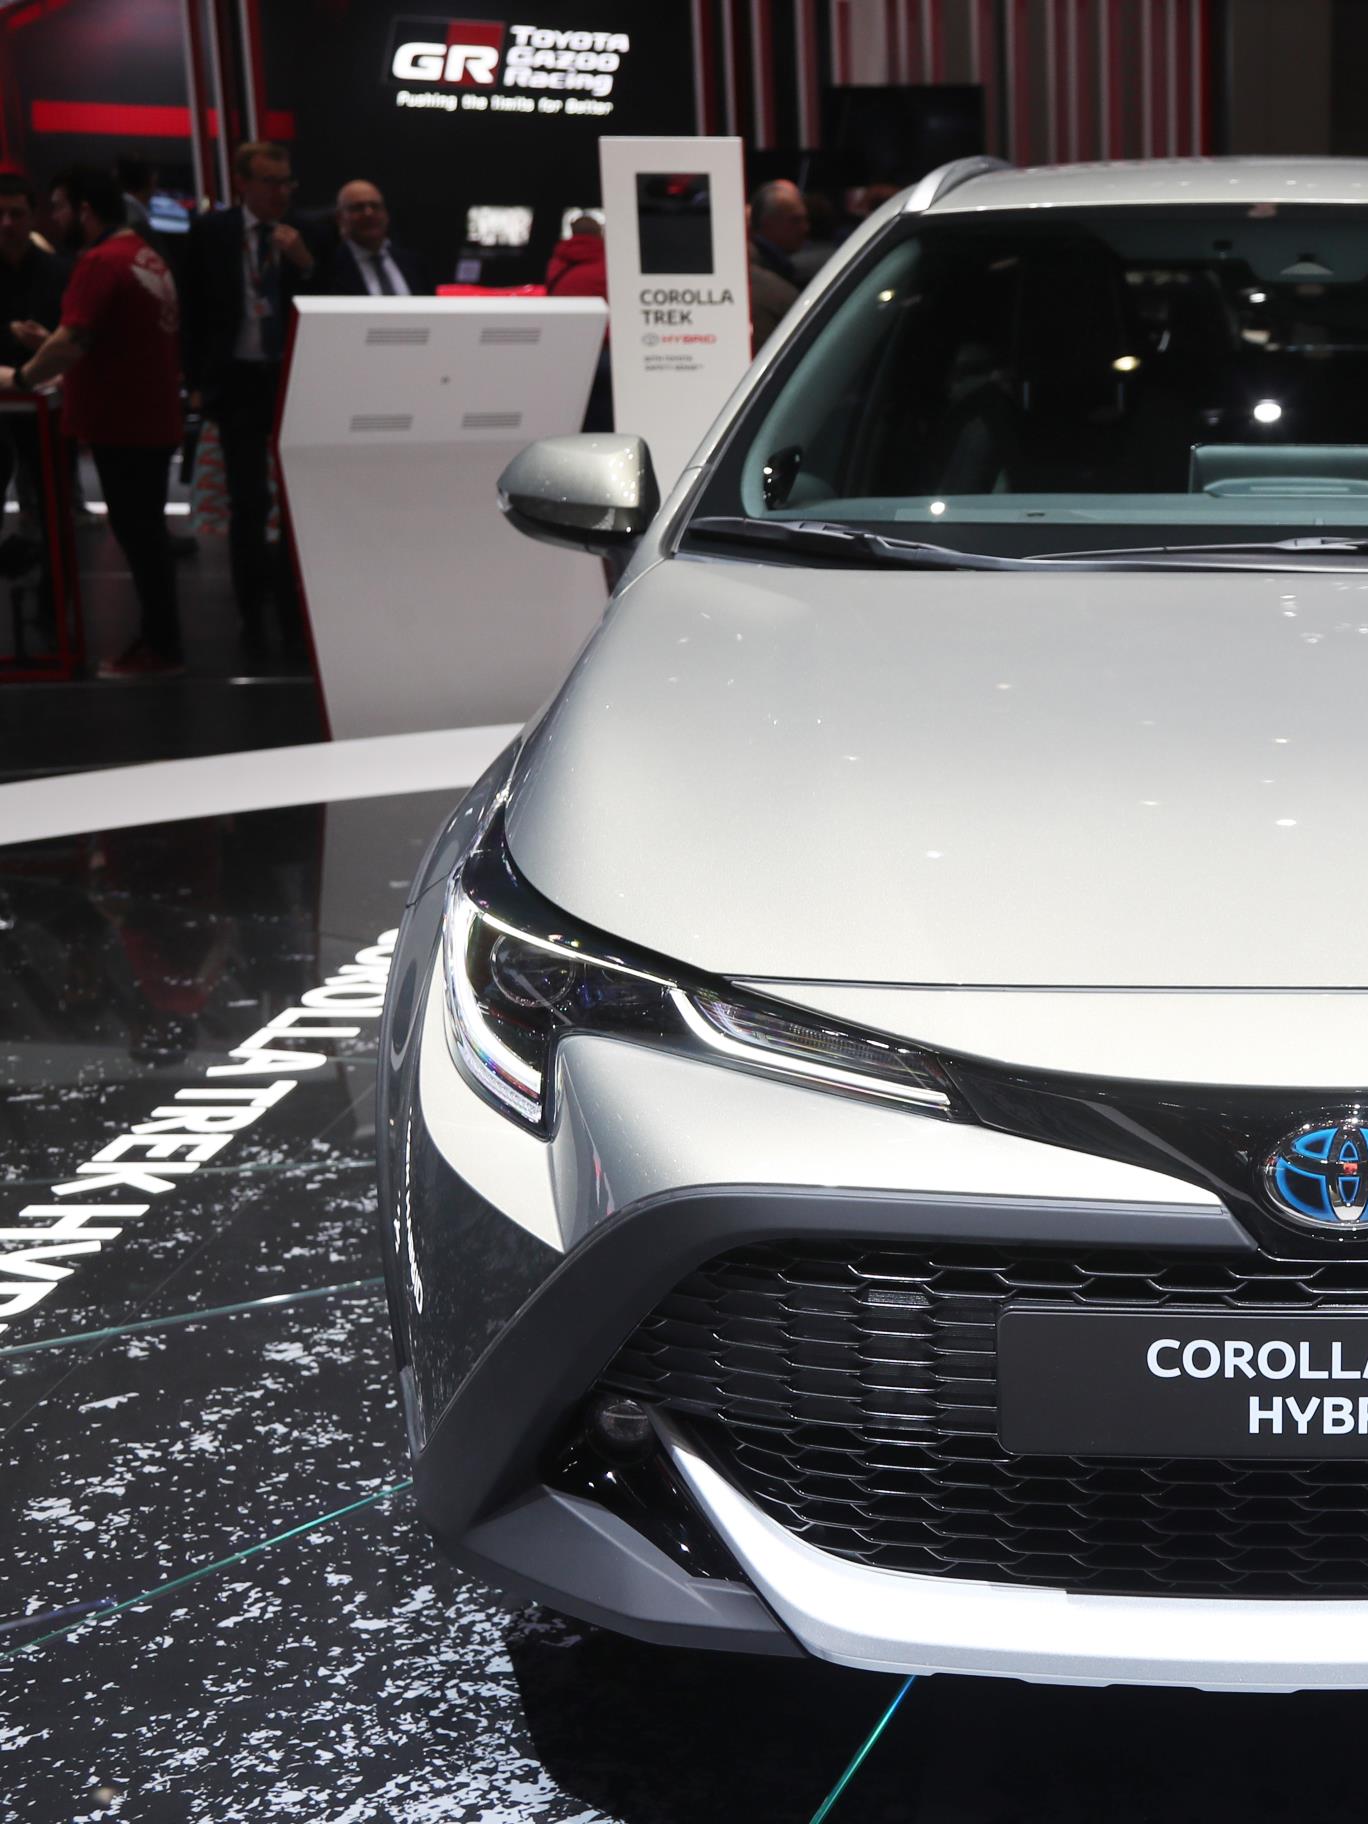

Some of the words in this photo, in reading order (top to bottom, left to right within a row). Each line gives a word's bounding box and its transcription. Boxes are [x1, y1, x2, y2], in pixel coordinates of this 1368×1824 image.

[392, 42, 499, 84] GR
[506, 46, 620, 72] GAZOO
[503, 66, 613, 96] Racing
[640, 289, 734, 305] COROLLA
[642, 311, 693, 325] TREK
[51, 1080, 298, 1196] TREK
